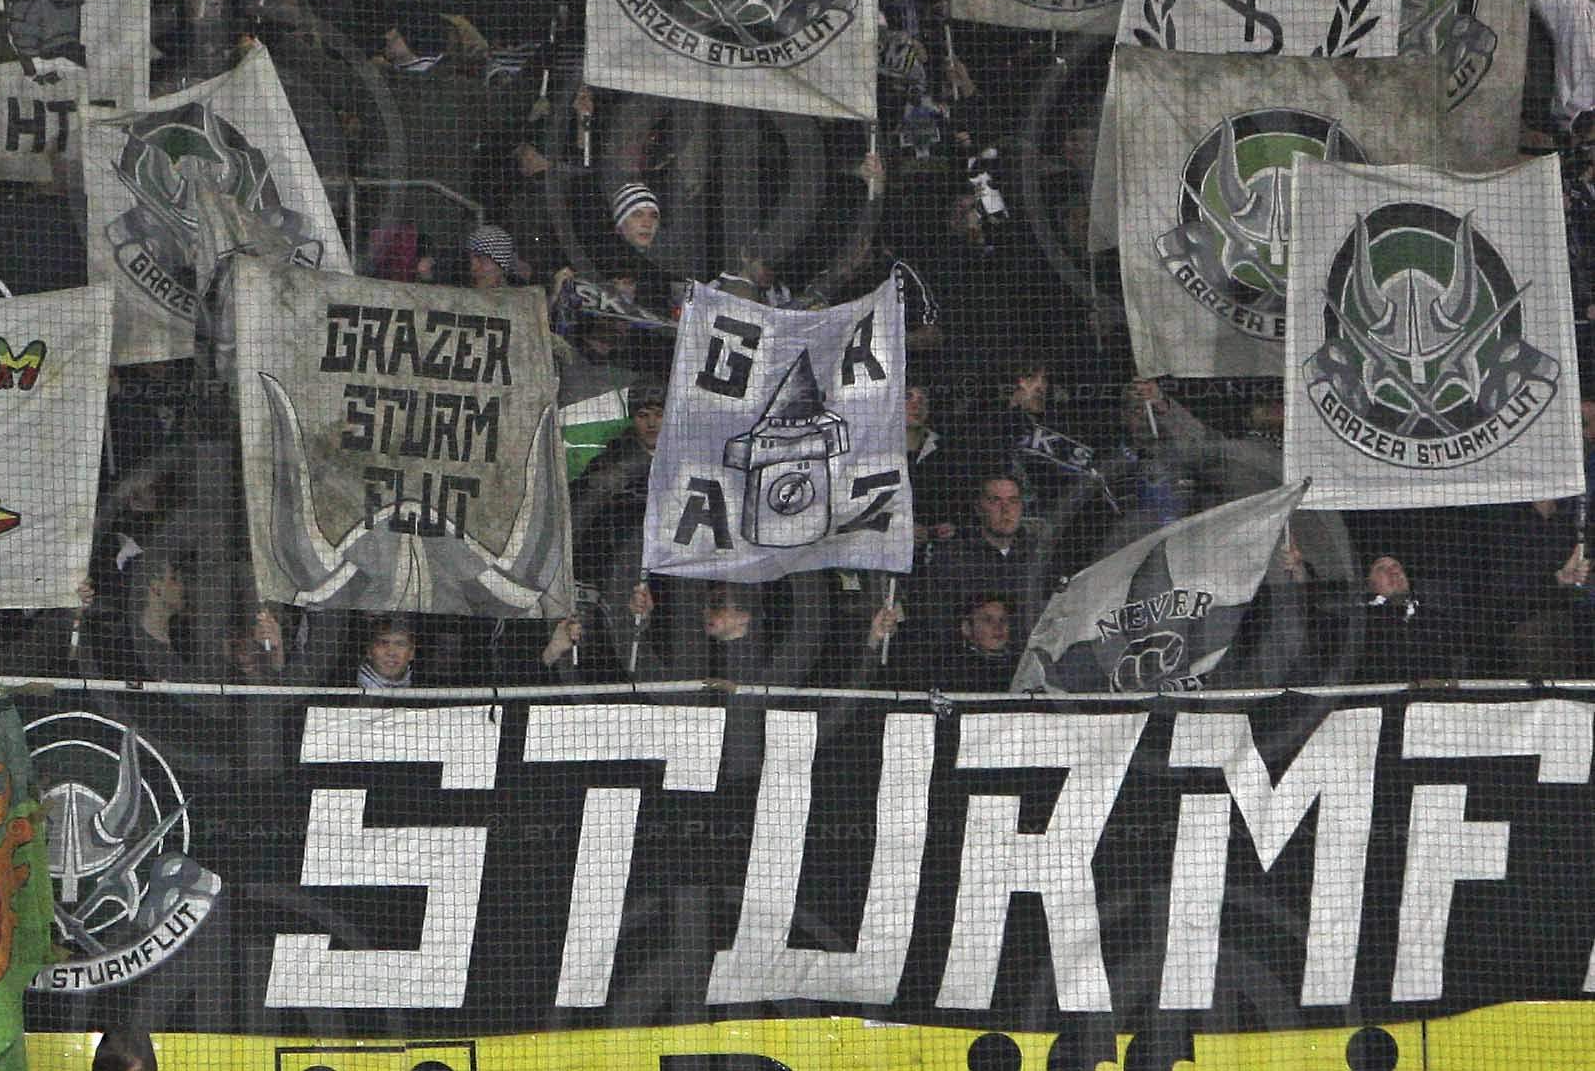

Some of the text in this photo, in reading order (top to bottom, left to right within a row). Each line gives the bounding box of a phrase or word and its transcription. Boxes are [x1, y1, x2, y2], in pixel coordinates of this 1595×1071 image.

[707, 12, 836, 65] STURMFLUT
[128, 249, 196, 316] GRAZE
[573, 283, 621, 314] SK
[1175, 262, 1266, 333] GRAZER
[321, 303, 512, 387] GRAZER
[694, 314, 763, 400] G
[340, 384, 500, 465] STURM
[1319, 386, 1542, 467] GRAZER STURMFLUT
[363, 466, 481, 540] FLUT
[673, 469, 901, 550] A Z
[1096, 589, 1216, 645] NEVER
[264, 697, 1595, 1013] STURMF
[51, 901, 202, 989] STURMFLUT
